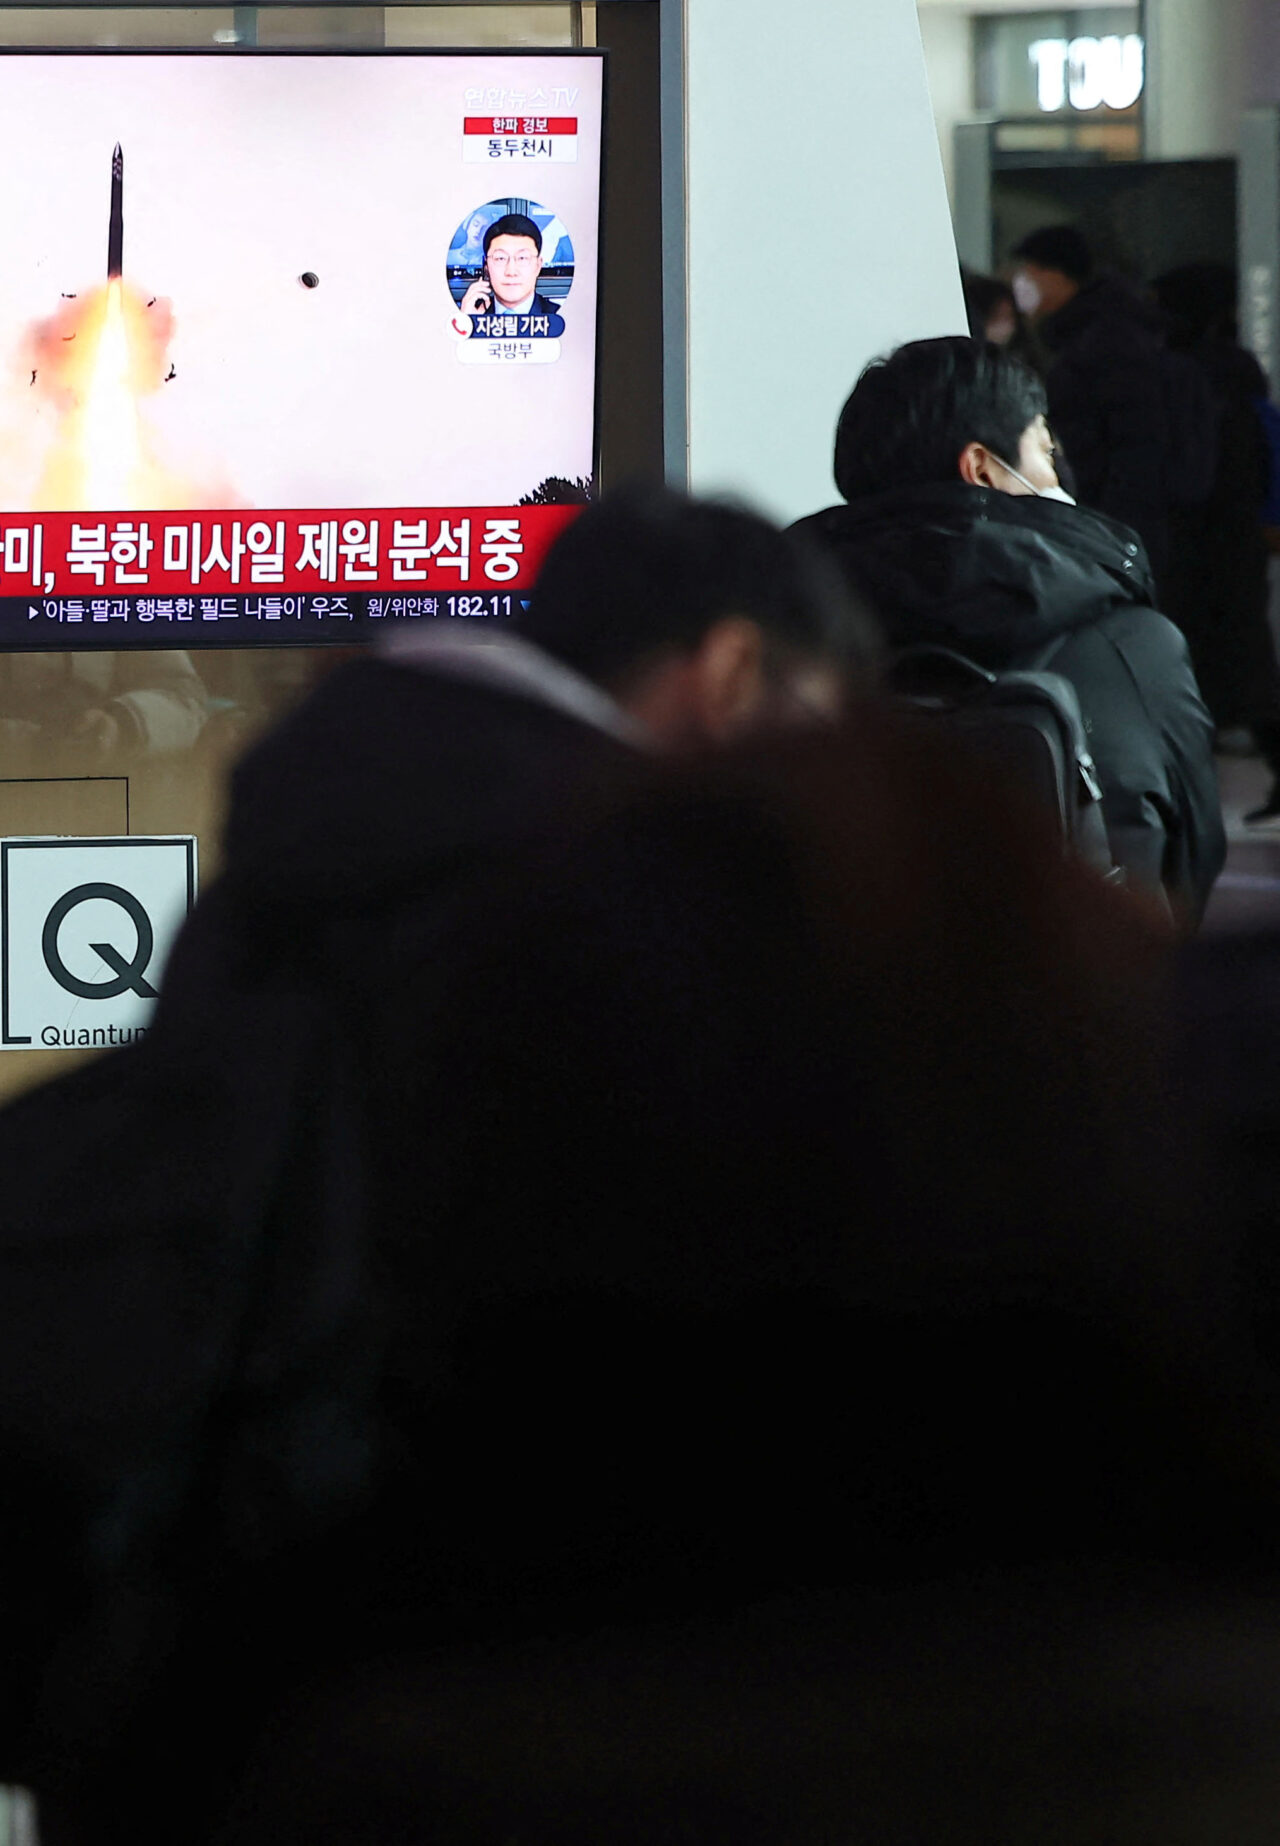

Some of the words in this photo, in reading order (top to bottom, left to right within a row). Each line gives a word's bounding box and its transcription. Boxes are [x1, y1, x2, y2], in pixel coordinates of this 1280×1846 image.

[463, 87, 579, 109] 연합뉴스TV
[492, 117, 518, 134] 한파
[522, 117, 548, 134] 경보
[487, 138, 552, 158] 동두천시
[521, 315, 549, 336] 기자
[487, 342, 532, 360] 국방부
[66, 522, 153, 585] 북한
[163, 520, 286, 584] 미사일
[295, 518, 379, 582] 제원
[388, 518, 471, 581] 분석
[480, 518, 524, 581] 중
[136, 599, 195, 622] 행복한
[200, 598, 240, 621] 필드
[244, 597, 305, 620] 나들이'
[310, 596, 354, 621] 우즈,
[367, 597, 439, 618] 원/위안화
[447, 596, 512, 616] 182.11
[41, 882, 161, 1000] Q
